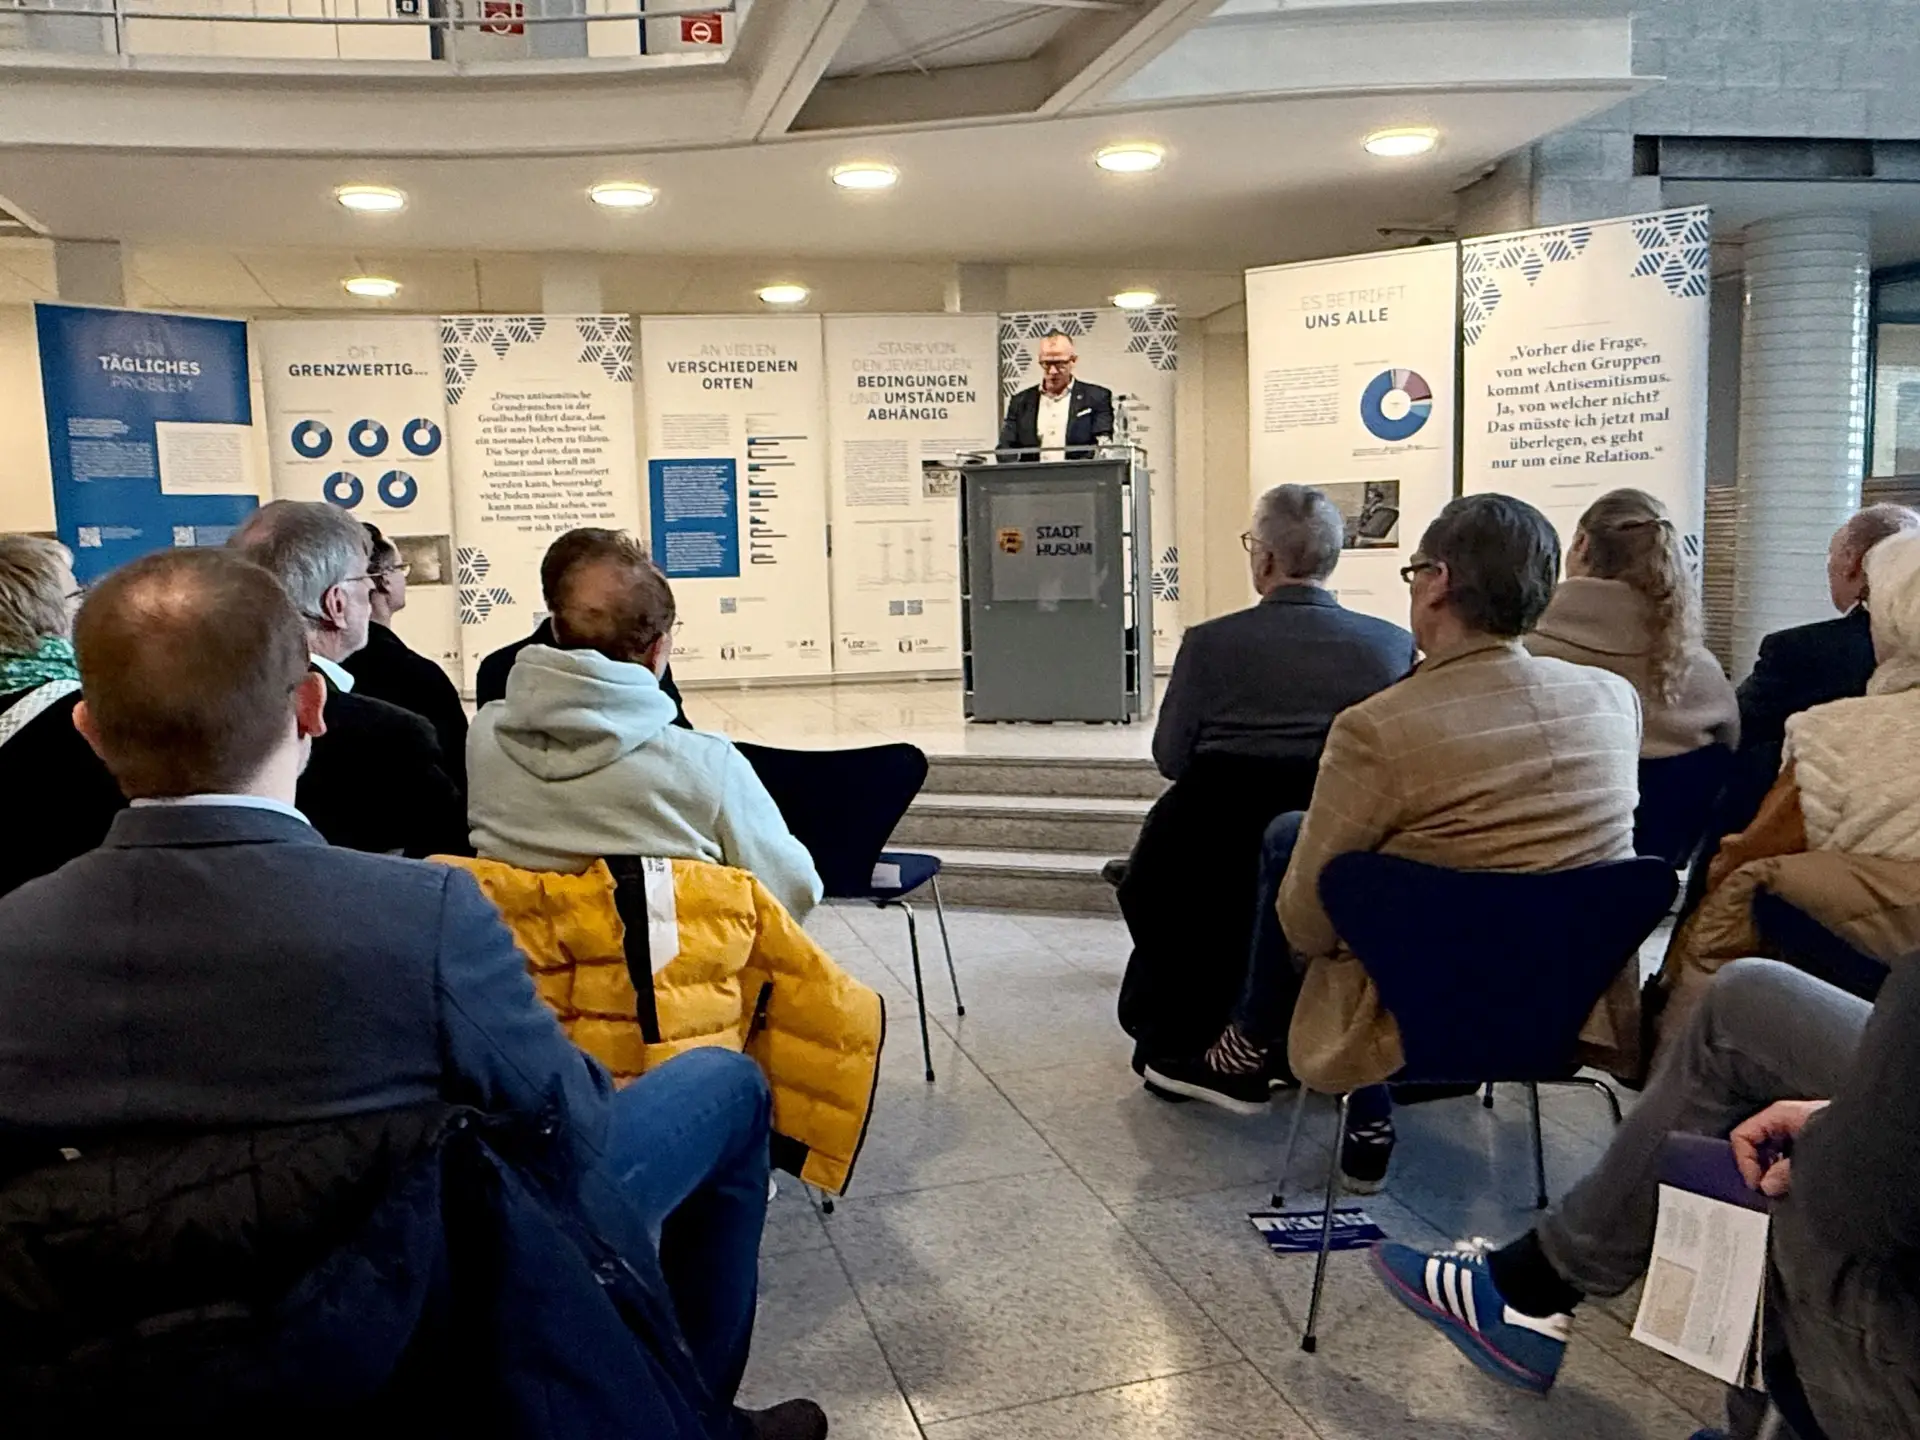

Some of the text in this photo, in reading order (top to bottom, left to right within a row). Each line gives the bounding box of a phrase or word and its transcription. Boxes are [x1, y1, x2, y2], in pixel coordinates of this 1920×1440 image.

[1300, 285, 1406, 311] ES BETRIFFT
[1305, 307, 1388, 329] UNS ALLE
[725, 343, 777, 356] VIELEN
[1510, 336, 1648, 361] „Vorher die Frage,
[98, 352, 201, 375] TÄGLICHES
[667, 360, 798, 373] VERSCHIEDENEN
[885, 358, 972, 371] JEWEILIGEN
[1496, 354, 1661, 378] von welchen Gruppen
[702, 377, 753, 389] ORTEN
[857, 375, 968, 388] BEDINGUNGEN
[884, 388, 976, 403] UMSTÄNDEN
[1487, 382, 1540, 397] kommt
[1496, 390, 1660, 416] Ja, von welcher nicht?
[867, 405, 948, 420] ABHÄNGIG
[1487, 408, 1670, 433] Das müsste ich jetzt mal
[1510, 429, 1644, 451] überlegen, es geht
[1491, 459, 1517, 469] nur
[1522, 457, 1545, 467] um
[1549, 453, 1581, 465] eine
[1036, 524, 1083, 539] STADT
[1036, 542, 1093, 556] HUSUM
